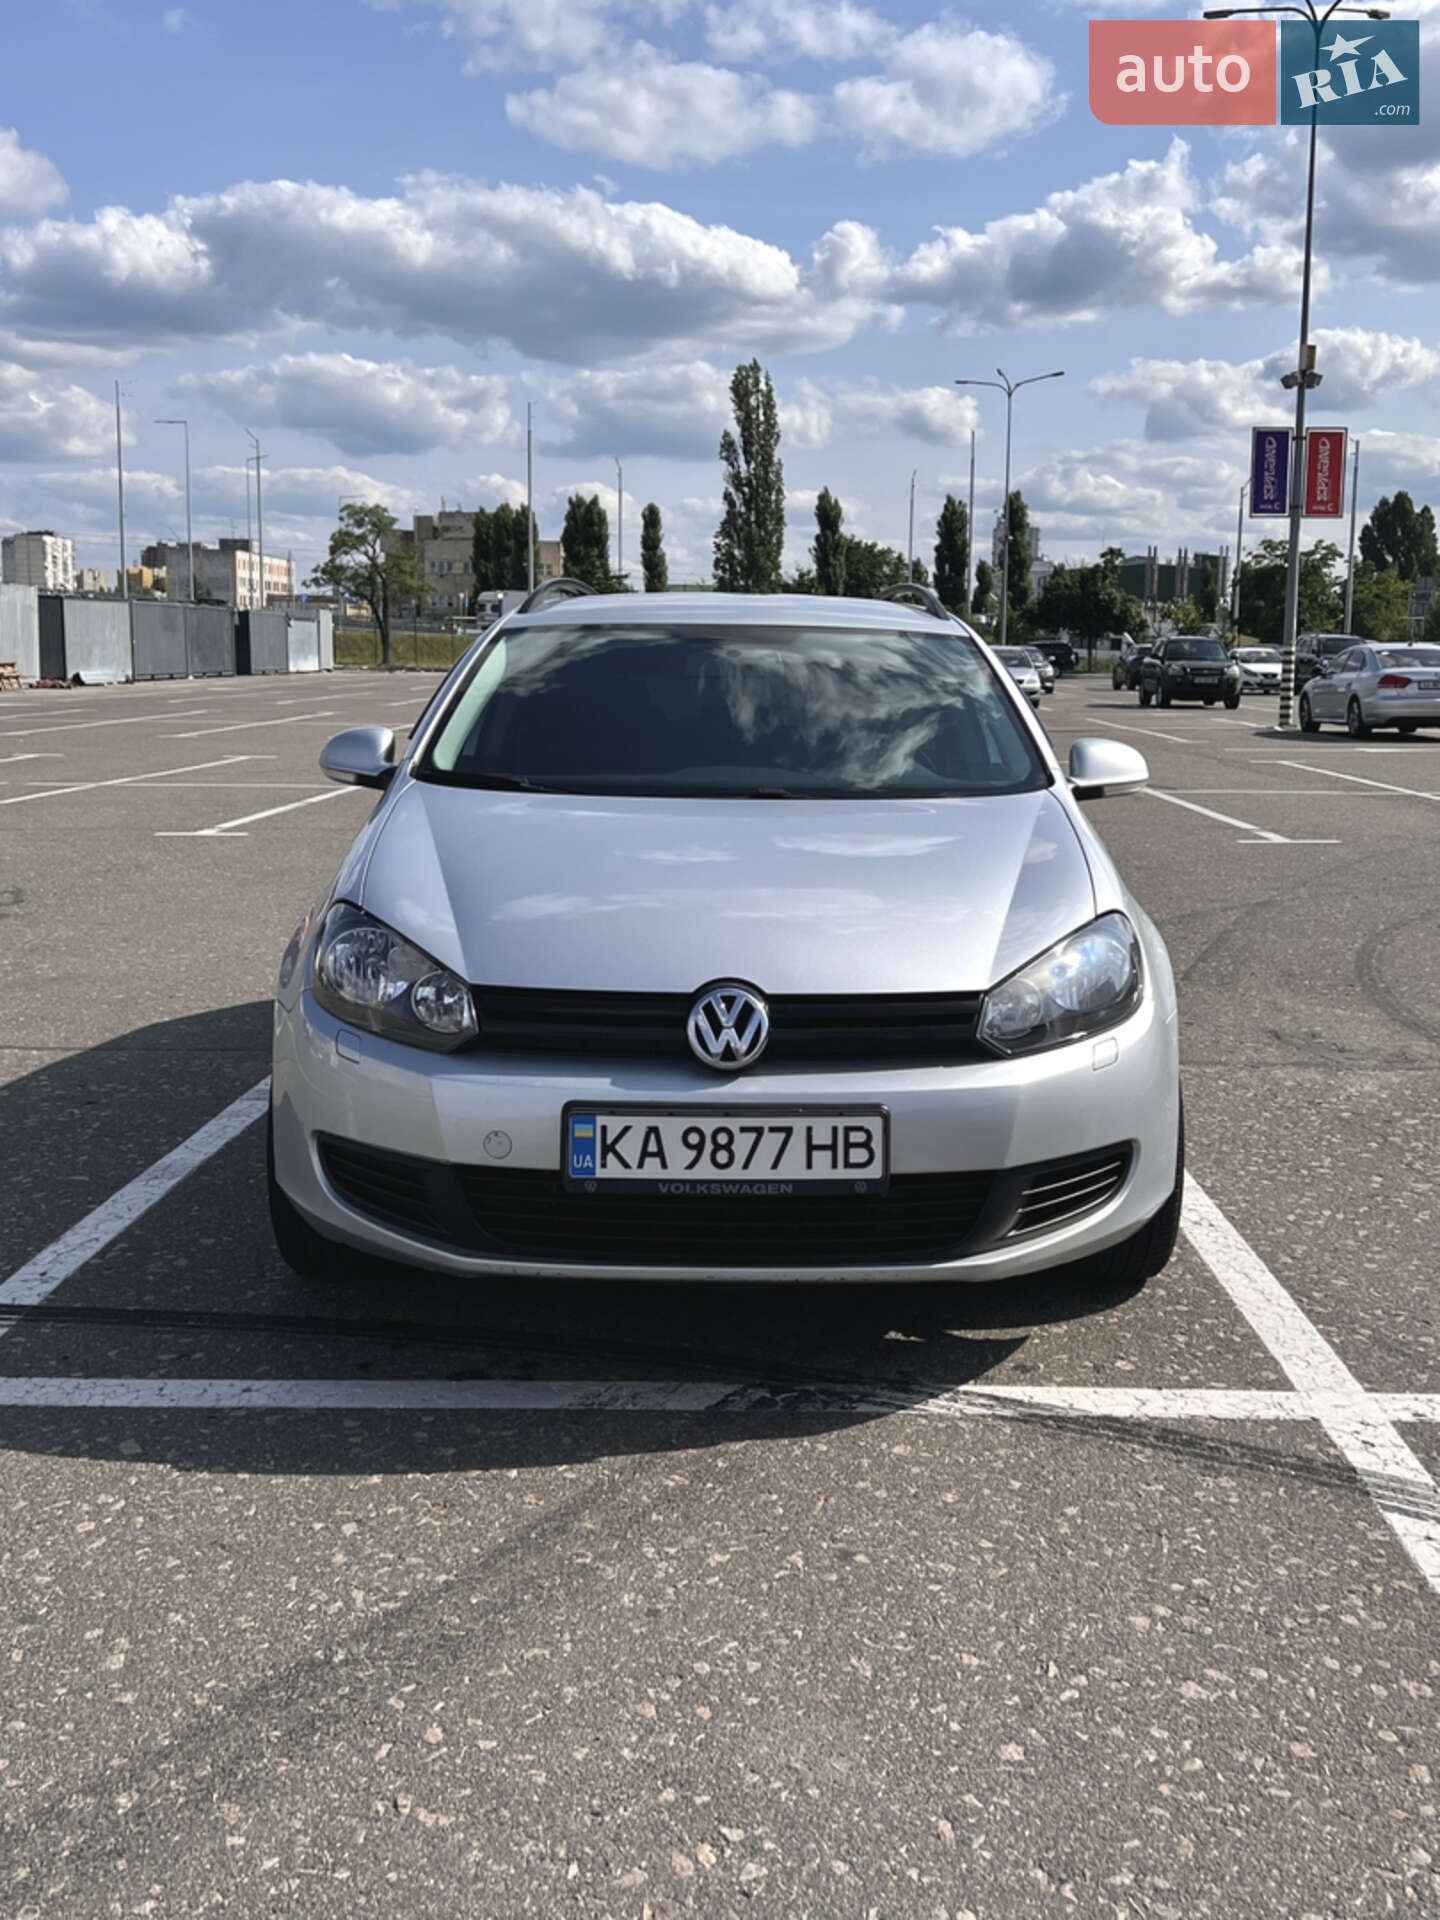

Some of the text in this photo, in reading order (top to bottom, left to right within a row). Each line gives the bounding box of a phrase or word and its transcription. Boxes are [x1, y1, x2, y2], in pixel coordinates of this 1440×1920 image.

[600, 1125, 876, 1171] KA 9877 HB
[573, 1153, 595, 1169] UA
[658, 1182, 794, 1195] VOLKSWAGEN
